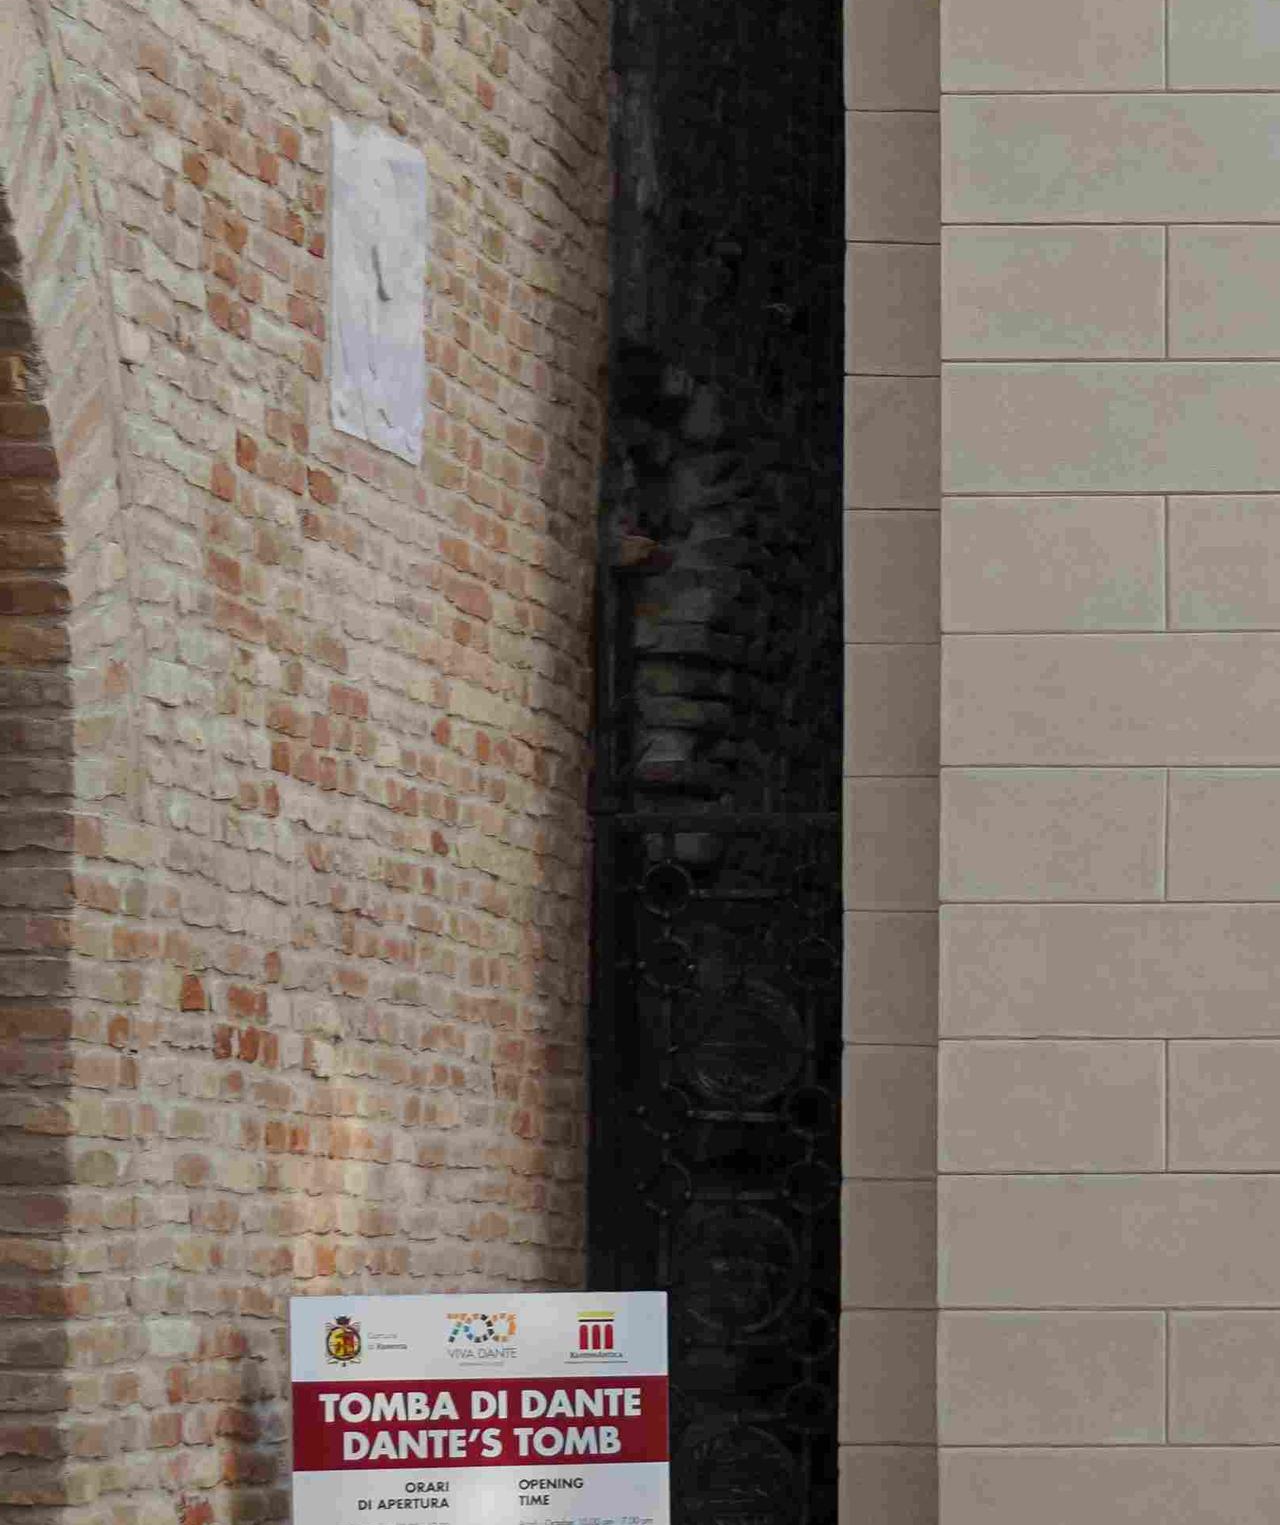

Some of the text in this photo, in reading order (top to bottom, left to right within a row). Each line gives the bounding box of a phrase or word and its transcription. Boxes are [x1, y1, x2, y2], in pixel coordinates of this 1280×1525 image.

[447, 1347, 518, 1360] VIVA DANTE
[319, 1388, 641, 1422] TOMBA DI DANTE
[343, 1426, 621, 1461] DANTE'S TOMB
[405, 1481, 450, 1493] ORARI
[519, 1477, 584, 1490] OPENING
[358, 1498, 450, 1511] DI APERTURA
[519, 1495, 550, 1506] TIME
